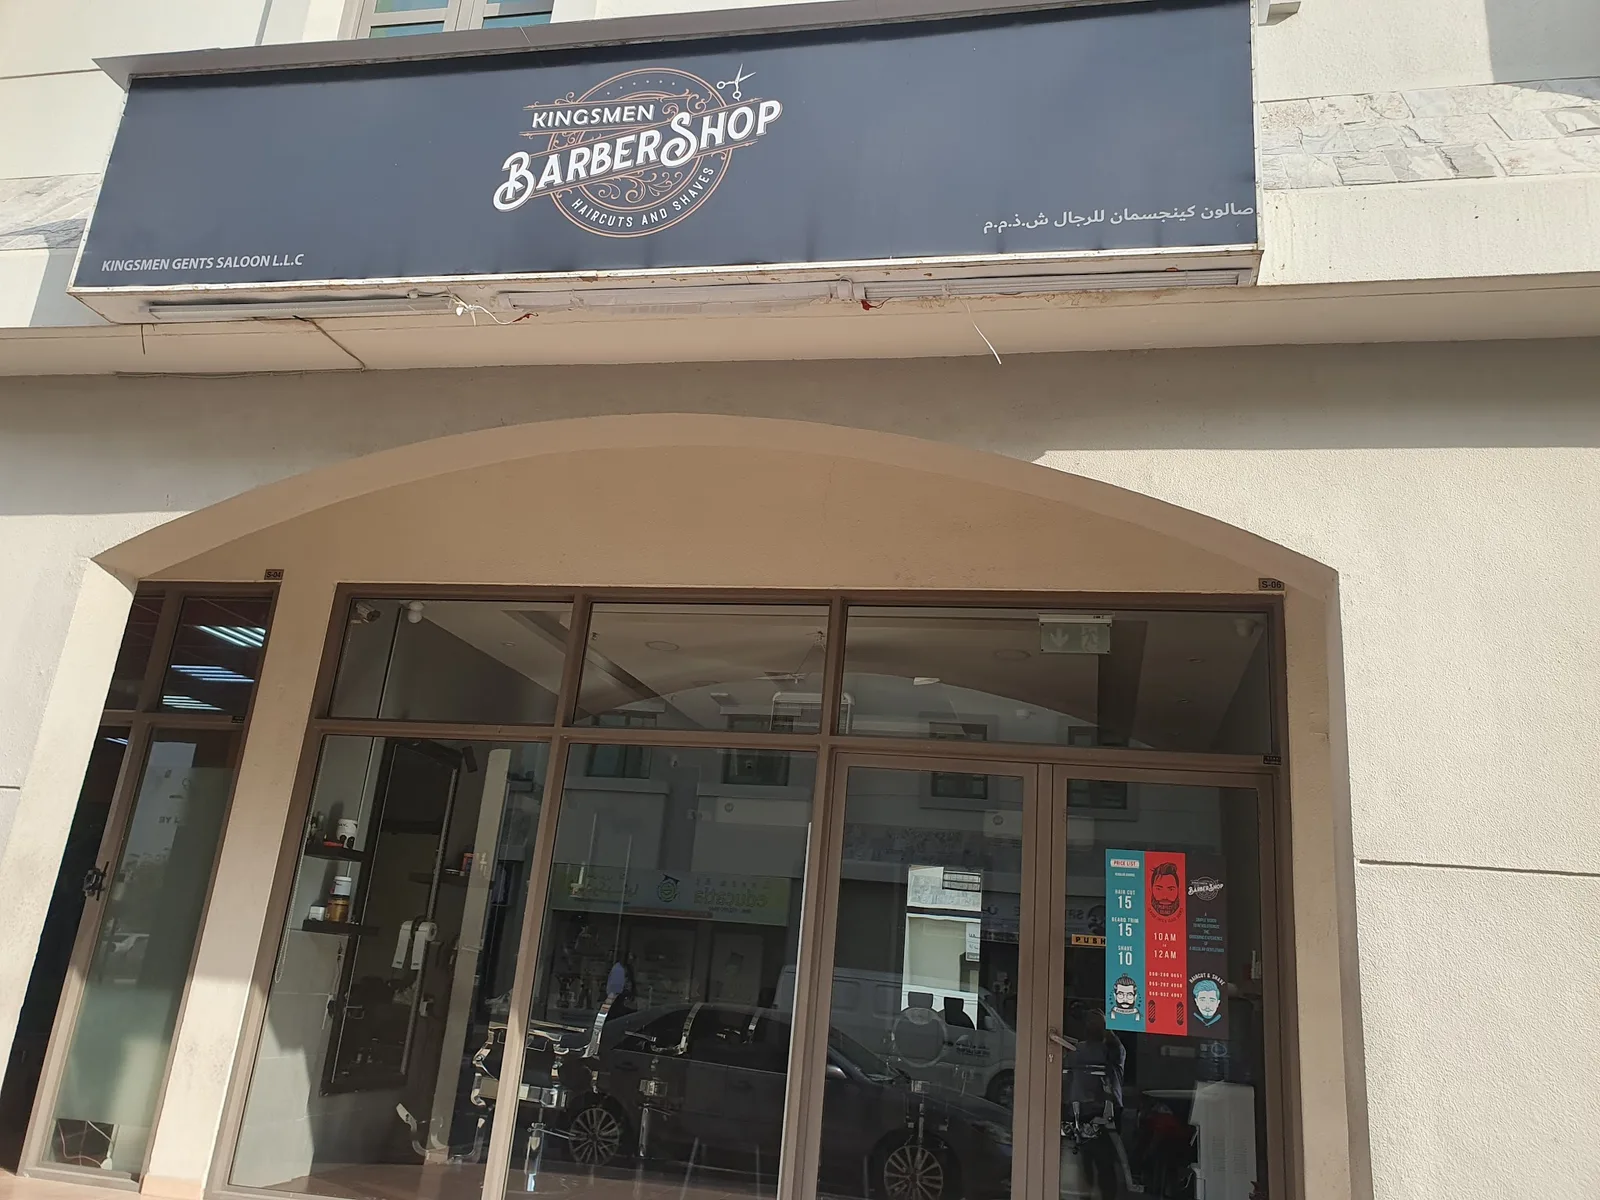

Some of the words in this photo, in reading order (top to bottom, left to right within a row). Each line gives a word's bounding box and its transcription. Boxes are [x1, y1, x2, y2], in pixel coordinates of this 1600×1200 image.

[531, 104, 655, 129] KINGSMEN
[492, 100, 783, 212] BARBERSHOP
[571, 198, 633, 228] HAIRCUTS
[641, 208, 668, 226] AND
[672, 166, 714, 211] SHAVES
[1053, 210, 1105, 228] للرجال
[1110, 205, 1196, 225] كينجسمان
[1200, 202, 1254, 220] صالون
[101, 258, 169, 272] KINGSMEN
[171, 257, 214, 270] GENTS
[215, 255, 271, 269] SALOON
[272, 253, 304, 267] L.L.C
[1261, 580, 1282, 589] S-06
[1117, 895, 1132, 909] 15
[1118, 923, 1132, 937] 15
[1153, 932, 1177, 941] 10AM
[1075, 936, 1106, 945] PUSH
[1118, 951, 1133, 966] 10
[1153, 949, 1177, 959] 12AM
